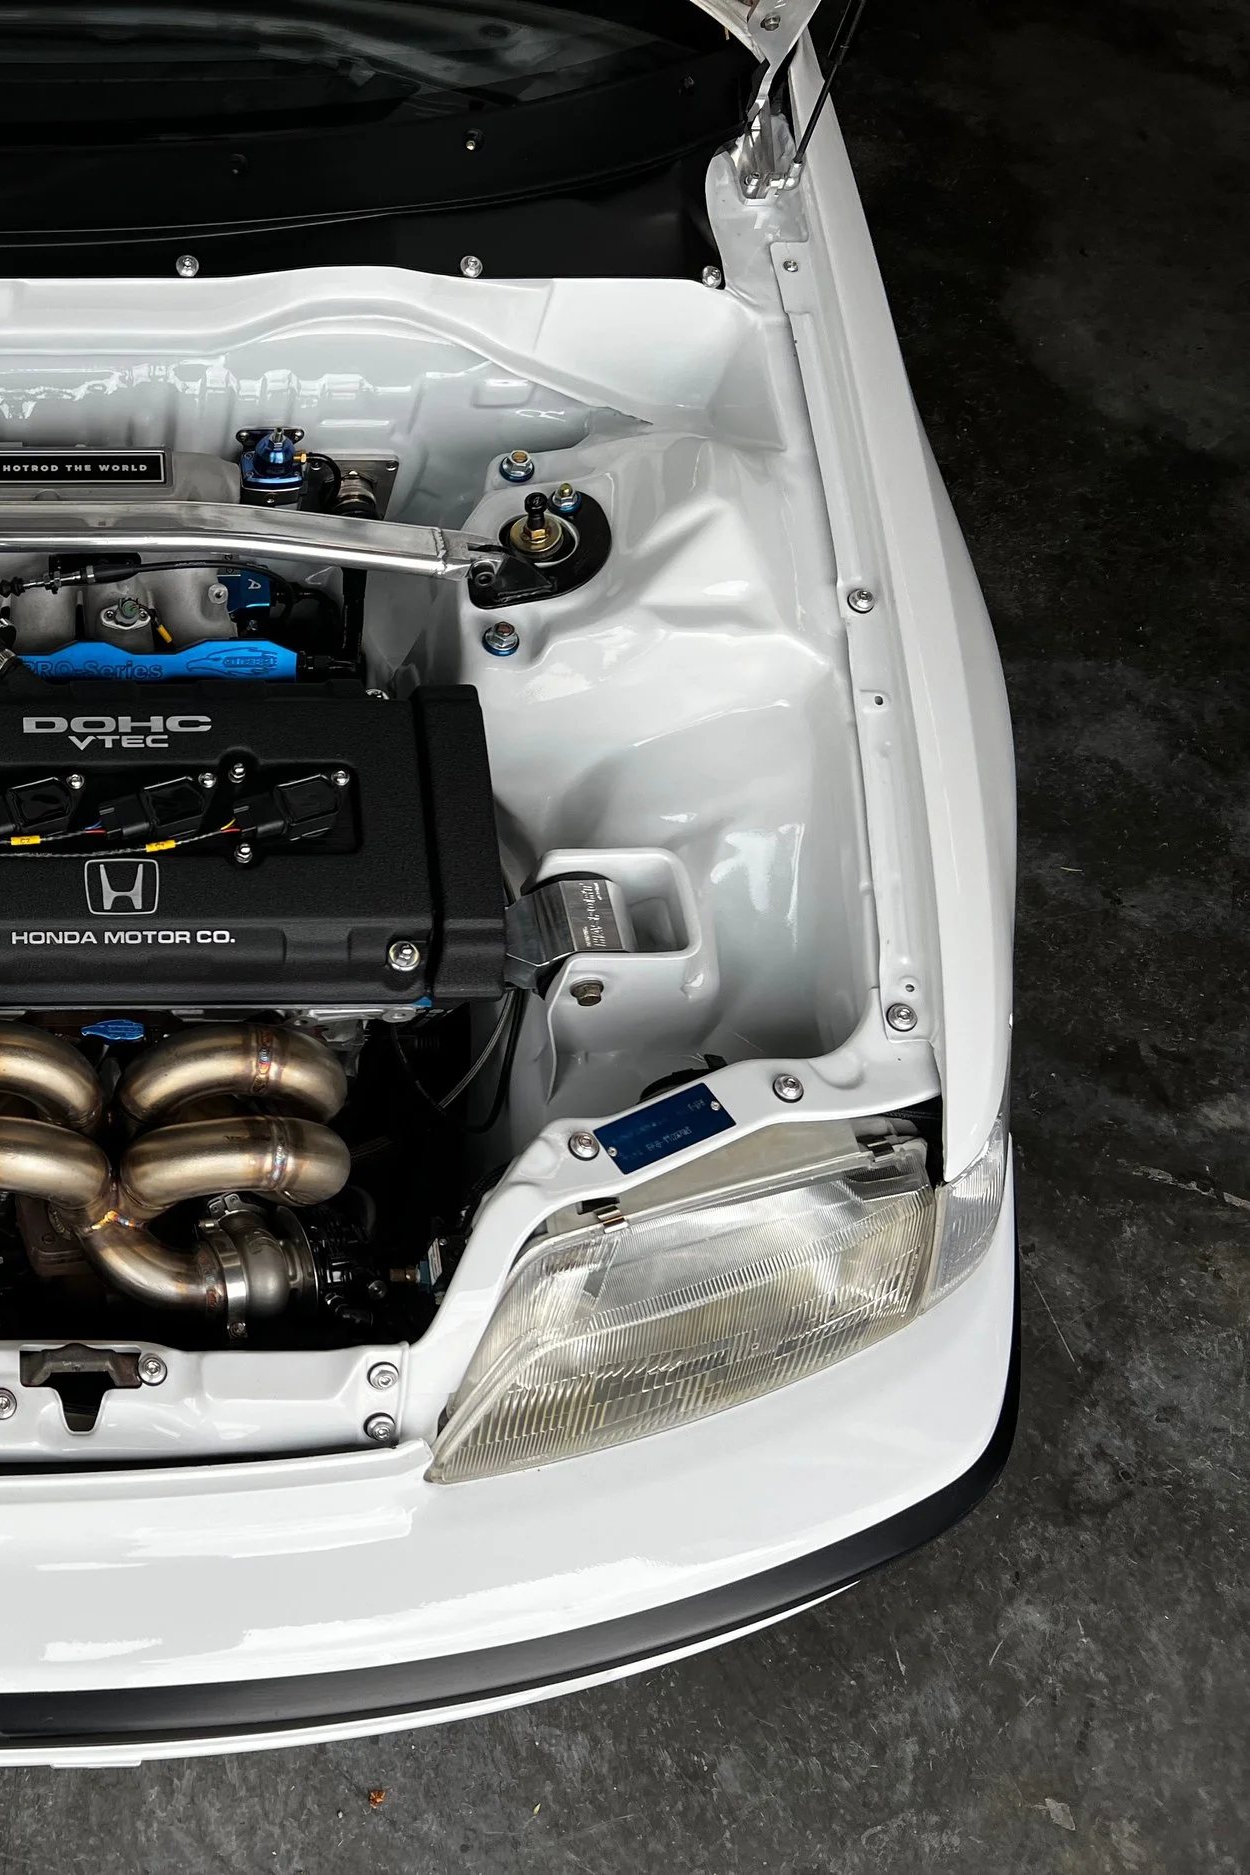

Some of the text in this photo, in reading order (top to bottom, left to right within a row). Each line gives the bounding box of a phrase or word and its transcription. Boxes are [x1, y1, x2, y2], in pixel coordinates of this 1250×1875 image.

[65, 464, 92, 472] THE
[99, 464, 148, 472] WORLD
[23, 715, 213, 734] DOHC
[68, 734, 169, 751] VTEC
[11, 930, 236, 945] HONDA MOTOR CO.
